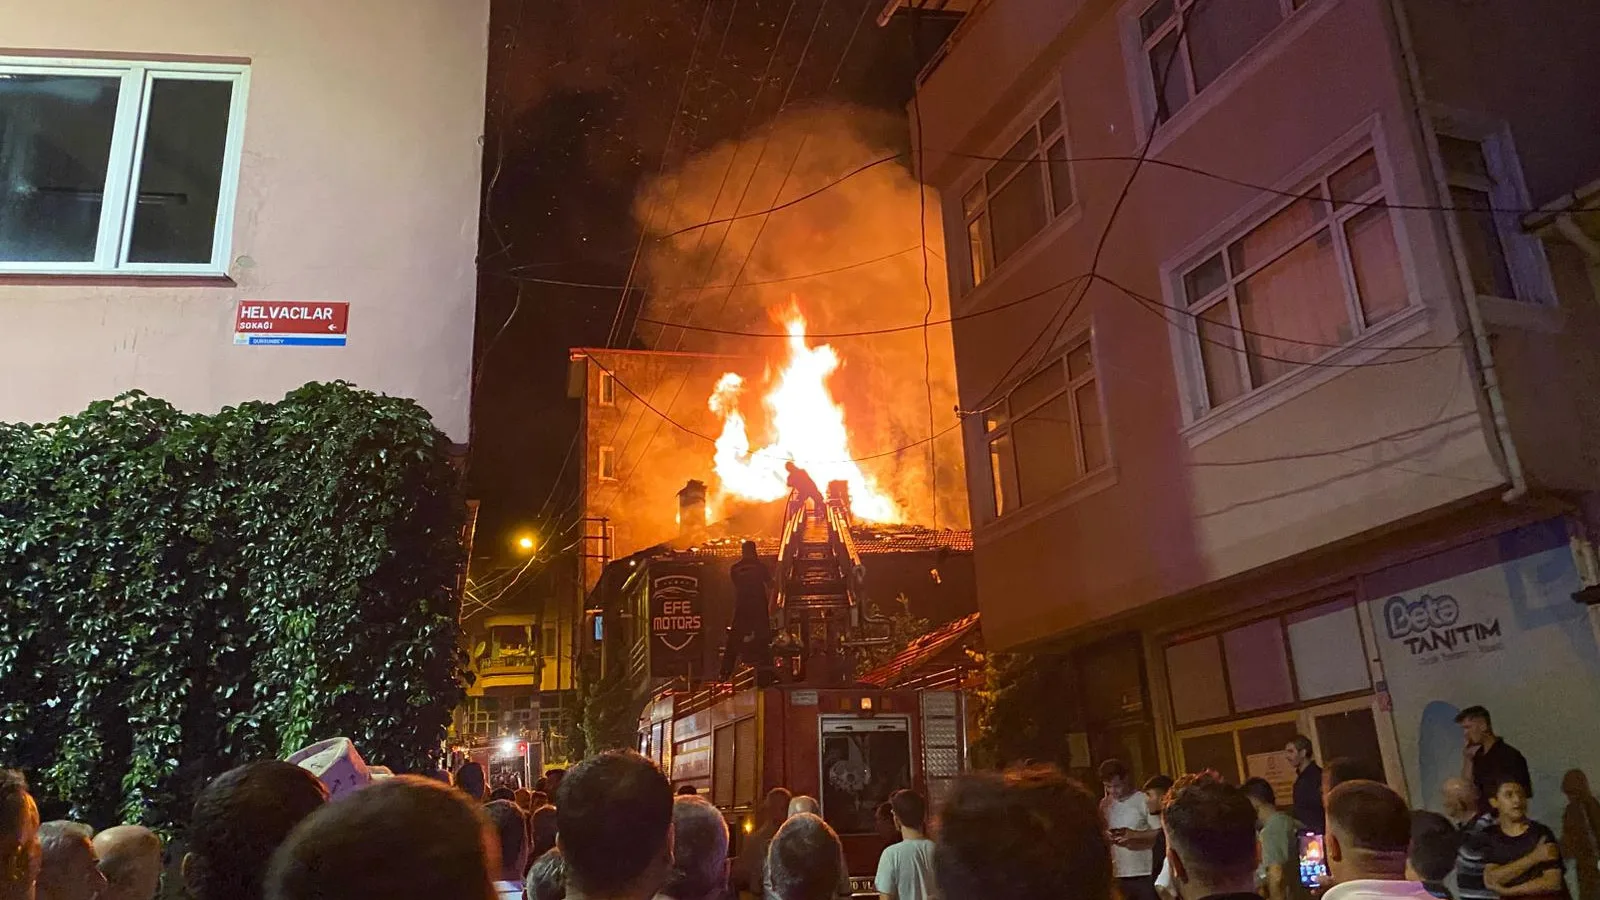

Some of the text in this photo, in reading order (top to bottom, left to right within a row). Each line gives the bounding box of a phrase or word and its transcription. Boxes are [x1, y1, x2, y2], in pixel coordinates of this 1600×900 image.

[240, 306, 333, 320] HELVACILAR
[239, 321, 273, 330] SOKAĞI
[663, 601, 691, 615] EFE
[653, 616, 701, 630] MOTORS
[1403, 619, 1502, 655] TANITIM
